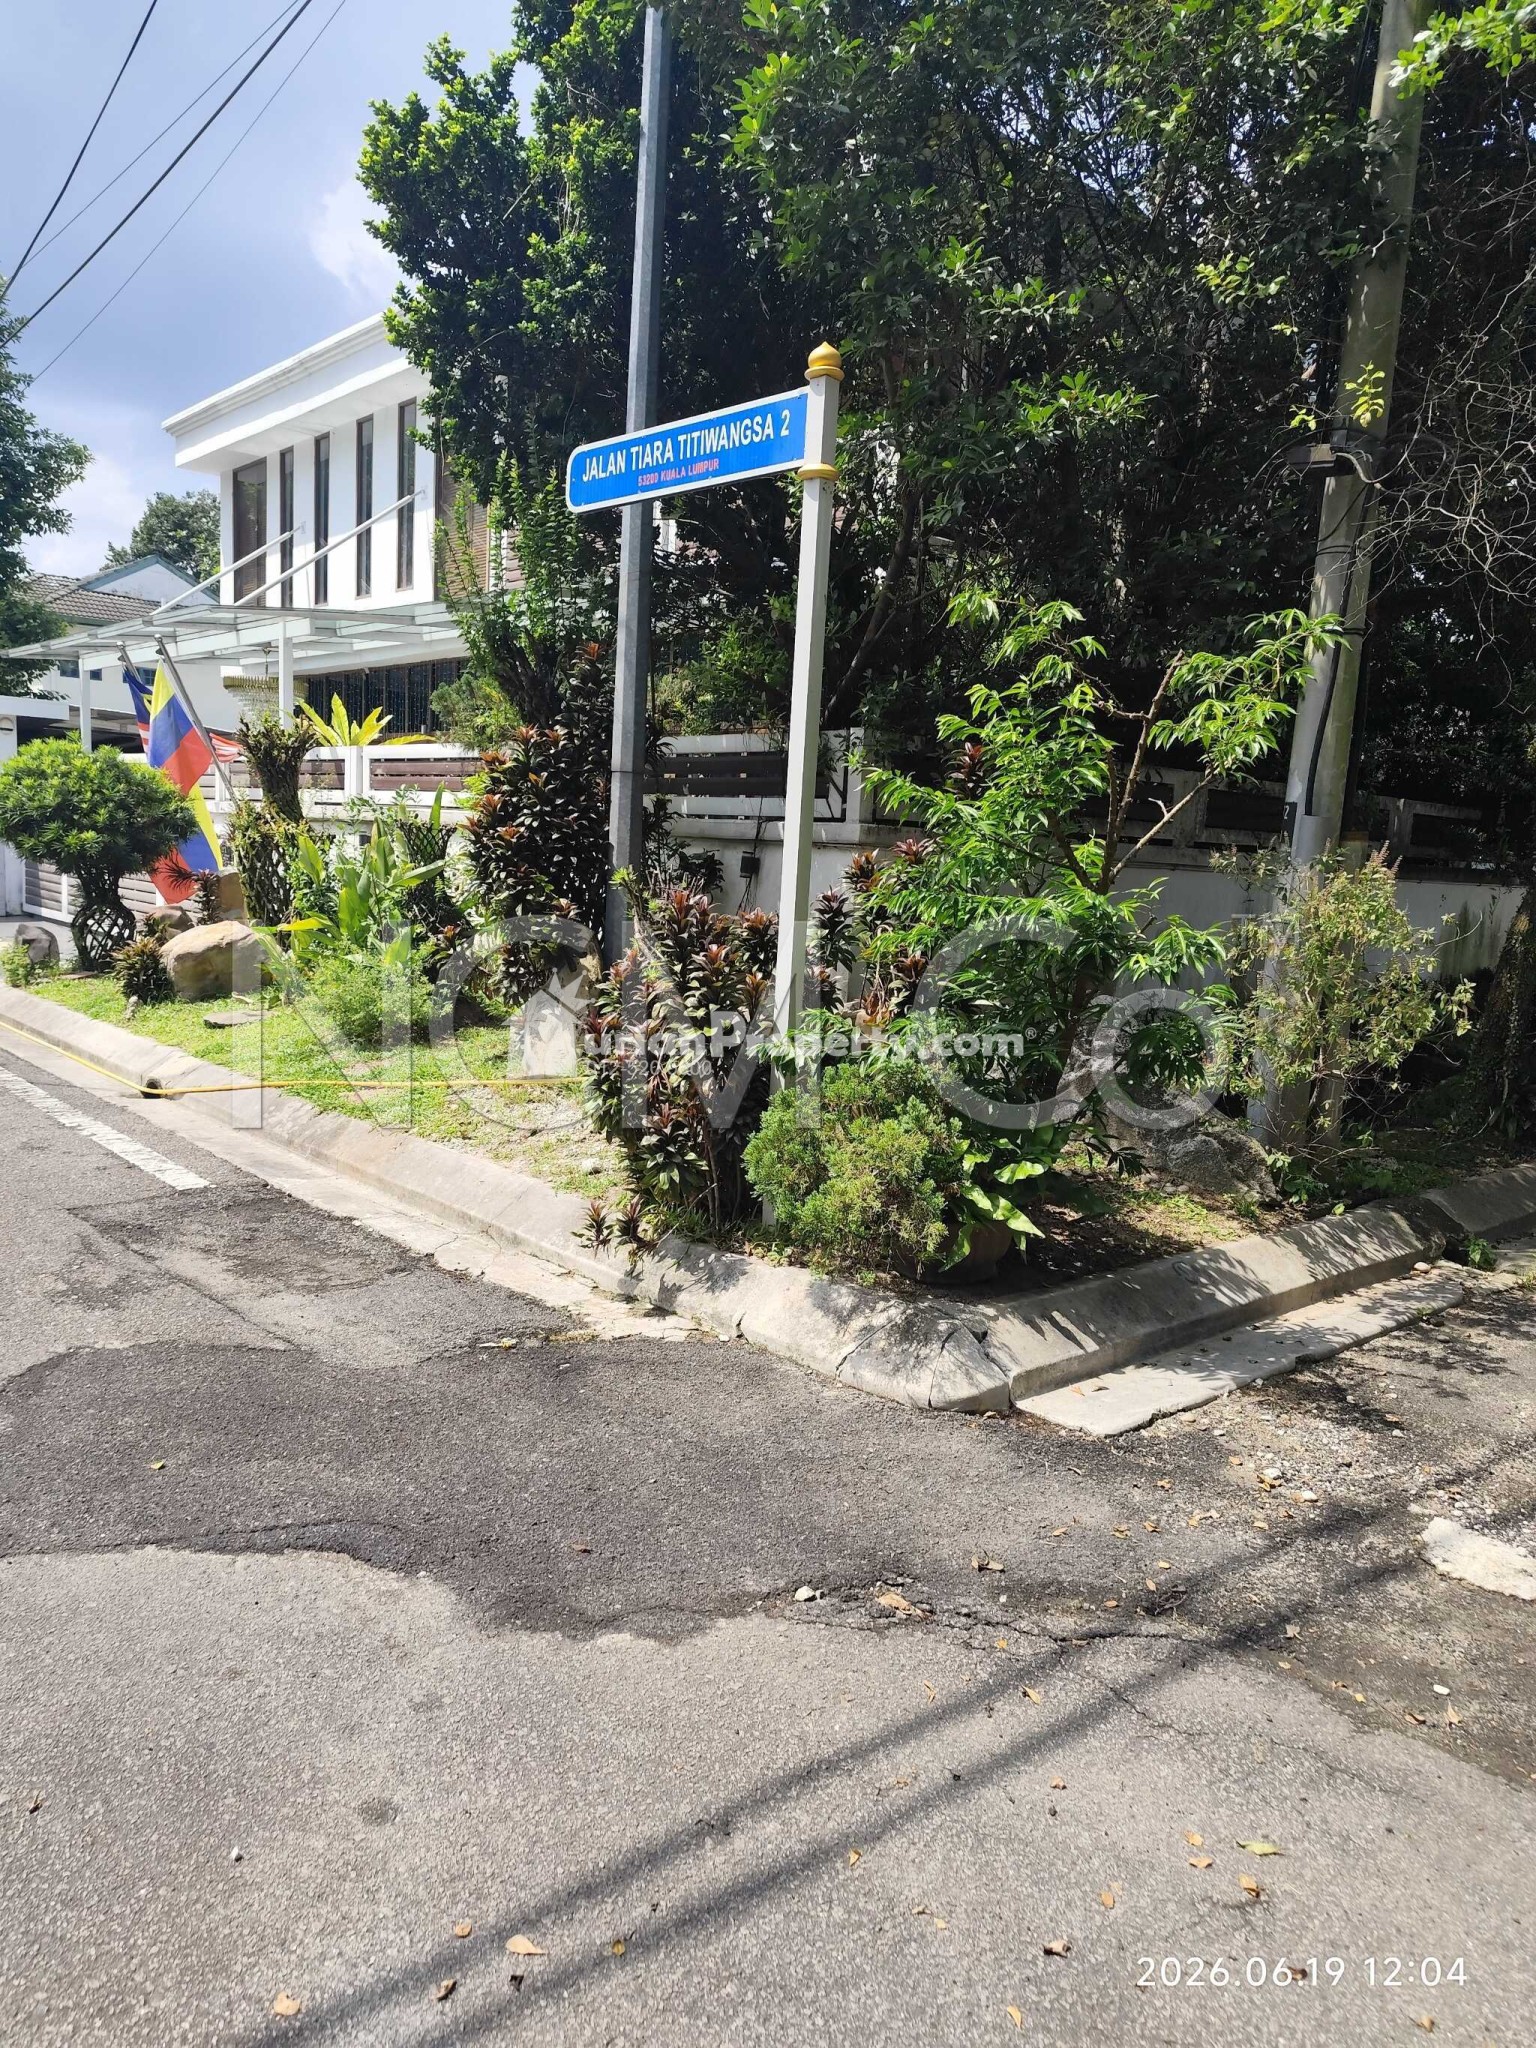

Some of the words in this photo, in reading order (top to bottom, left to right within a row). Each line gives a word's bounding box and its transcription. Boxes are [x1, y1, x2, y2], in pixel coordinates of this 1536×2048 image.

[582, 449, 626, 483] JALAN
[630, 437, 675, 470] TIARA
[678, 413, 774, 461] TITIWANGSA
[781, 409, 791, 437] 2
[638, 472, 658, 487] 53200
[661, 466, 686, 482] KUALA
[688, 458, 719, 476] LUMPUR
